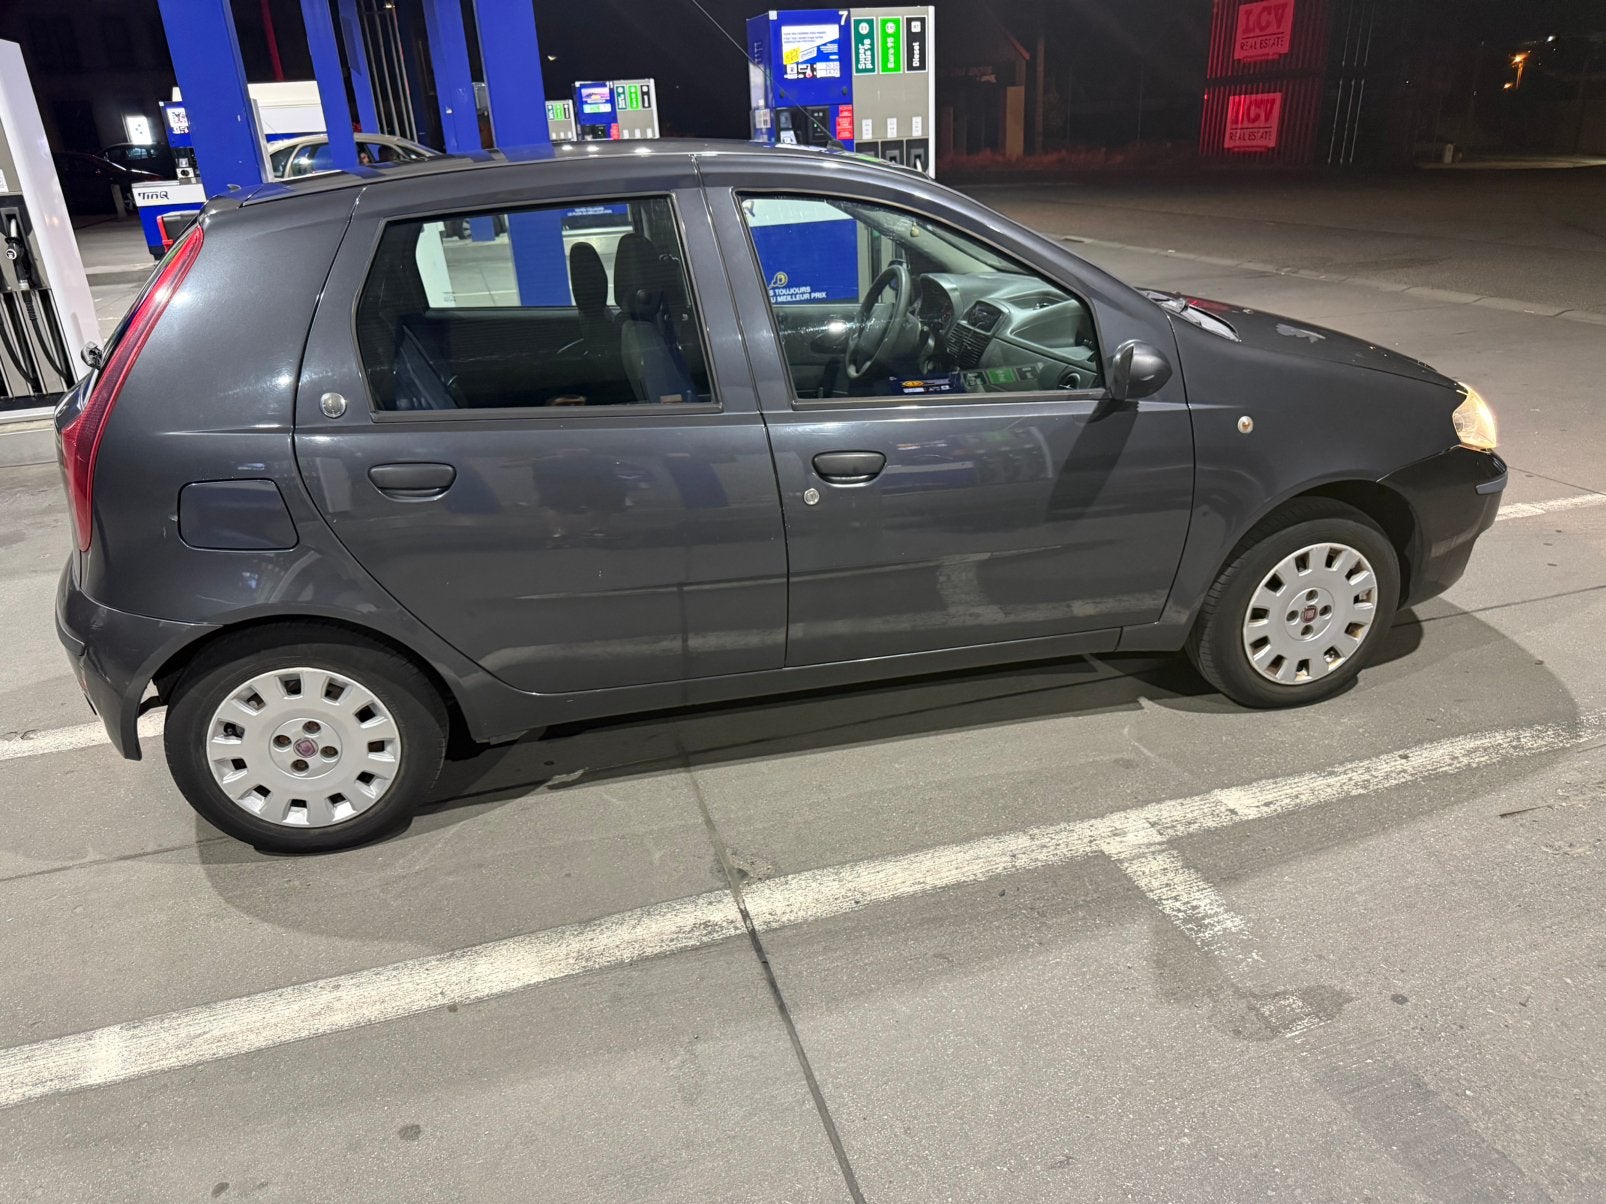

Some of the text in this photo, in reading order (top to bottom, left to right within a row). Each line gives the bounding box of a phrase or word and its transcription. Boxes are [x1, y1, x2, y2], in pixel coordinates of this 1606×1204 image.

[838, 10, 849, 26] 7
[1240, 36, 1285, 51] REAL ESTATE
[857, 43, 866, 70] Super
[863, 38, 873, 69] plus 98
[886, 37, 895, 69] Euro 95
[912, 41, 920, 67] Diesel
[1229, 130, 1272, 141] REAL ESTATE
[137, 190, 170, 200] TinQ
[775, 286, 811, 296] TOUJOURS
[777, 293, 810, 302] MEILLEUR
[811, 291, 827, 299] PRIX
